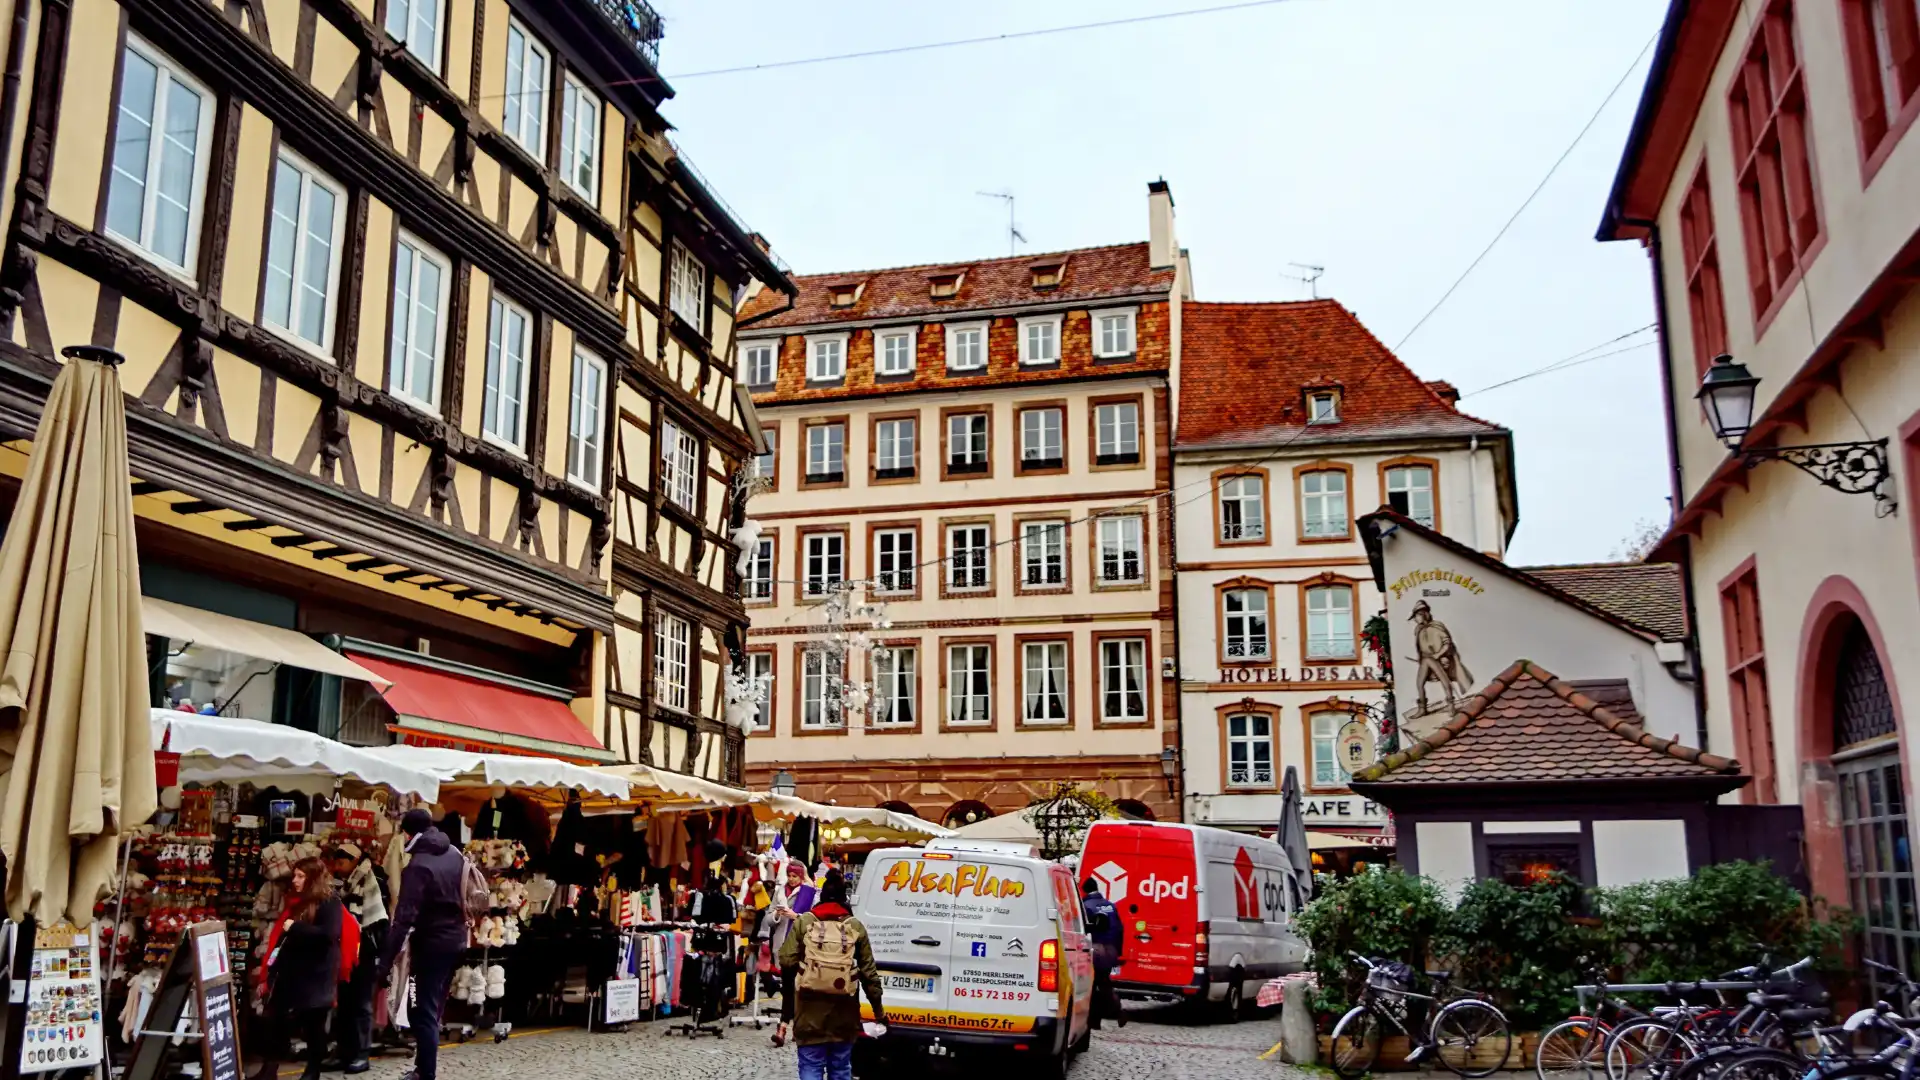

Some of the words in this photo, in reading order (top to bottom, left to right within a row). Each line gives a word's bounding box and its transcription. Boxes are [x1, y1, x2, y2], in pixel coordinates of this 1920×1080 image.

[1300, 667, 1339, 681] DES
[882, 860, 1025, 898] AlsaFlam
[1138, 872, 1189, 904] dpd
[1263, 870, 1286, 922] dpd
[908, 901, 923, 909] pour
[933, 902, 949, 910] Tarte
[916, 908, 950, 918] Fabrication
[972, 977, 1017, 986] GEISPOLSHEIM
[954, 987, 967, 997] 06
[970, 989, 983, 998] 15
[986, 990, 999, 1000] 72
[1002, 991, 1015, 1001] 18
[1017, 992, 1030, 1002] 97
